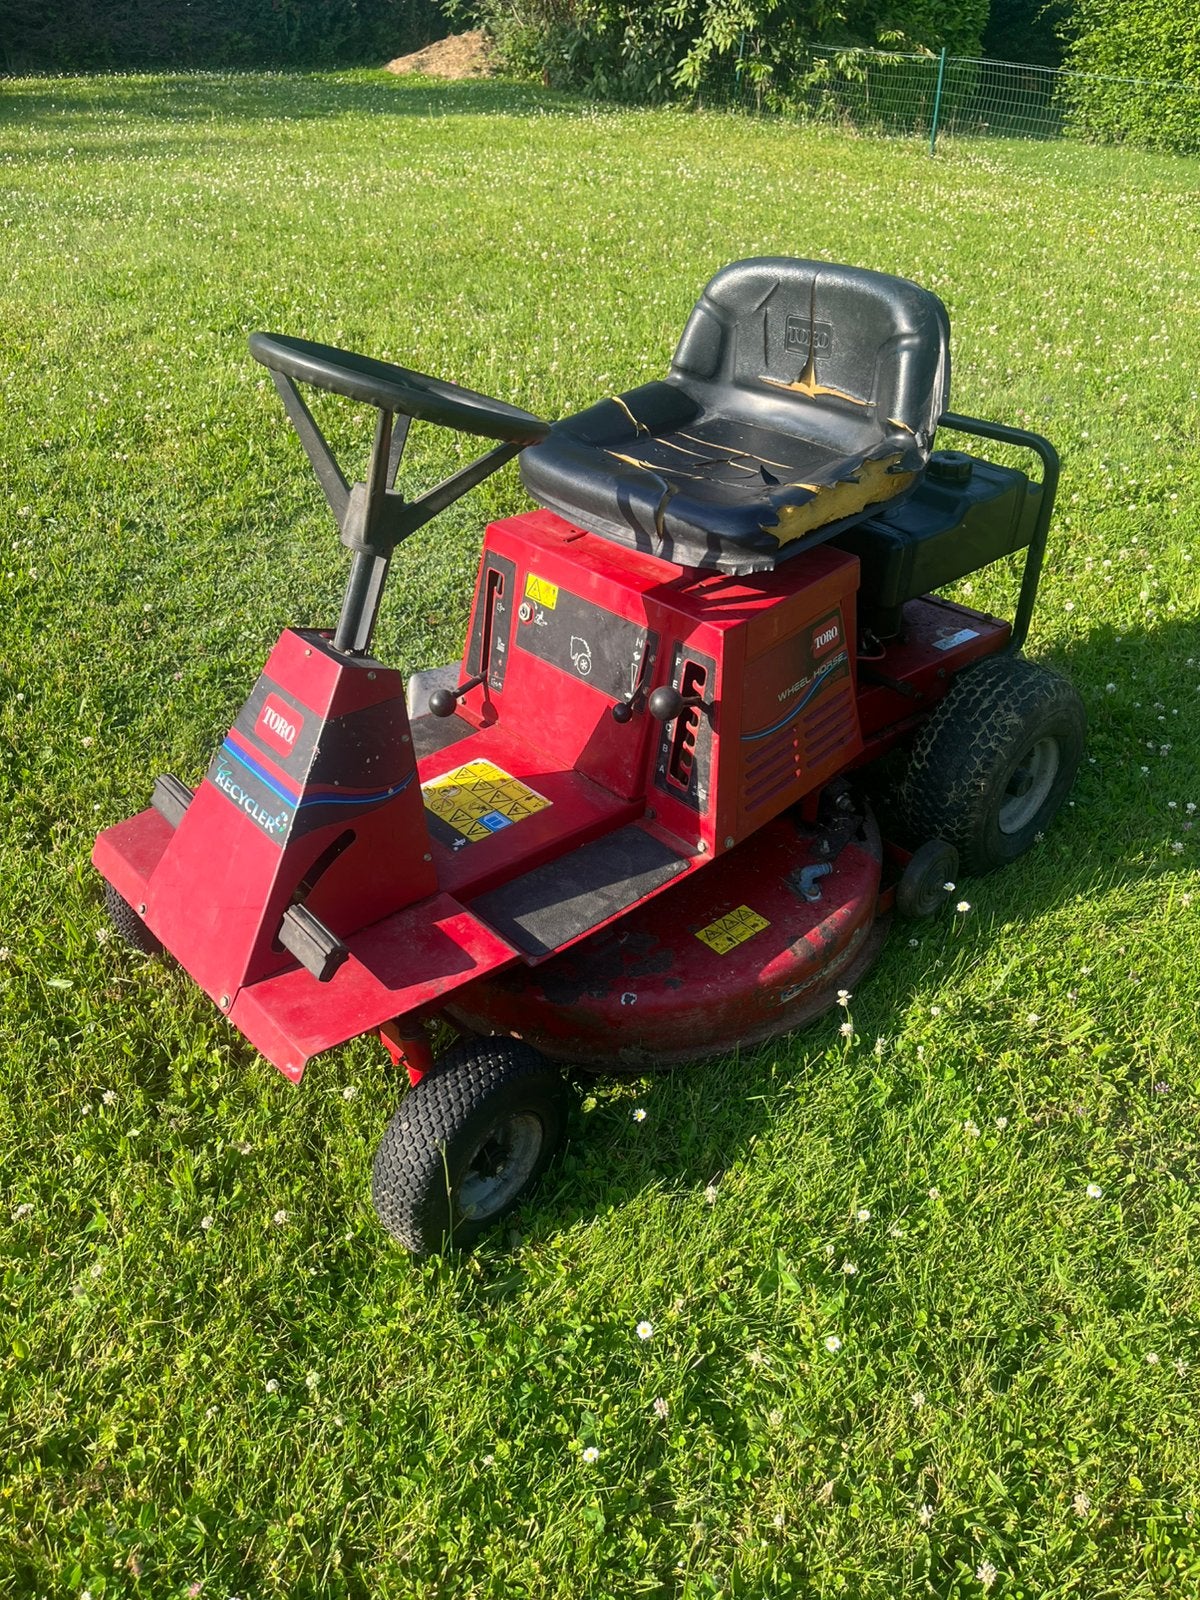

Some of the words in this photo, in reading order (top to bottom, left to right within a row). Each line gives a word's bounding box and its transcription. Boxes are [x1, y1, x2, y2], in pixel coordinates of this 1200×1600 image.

[635, 637, 644, 649] N
[814, 626, 839, 649] TORO
[675, 657, 682, 666] F
[777, 676, 812, 702] WHEEL
[813, 650, 849, 679] HORSE
[672, 679, 679, 690] E
[662, 743, 669, 753] B
[658, 764, 665, 774] A
[215, 770, 276, 834] RECYCLER
